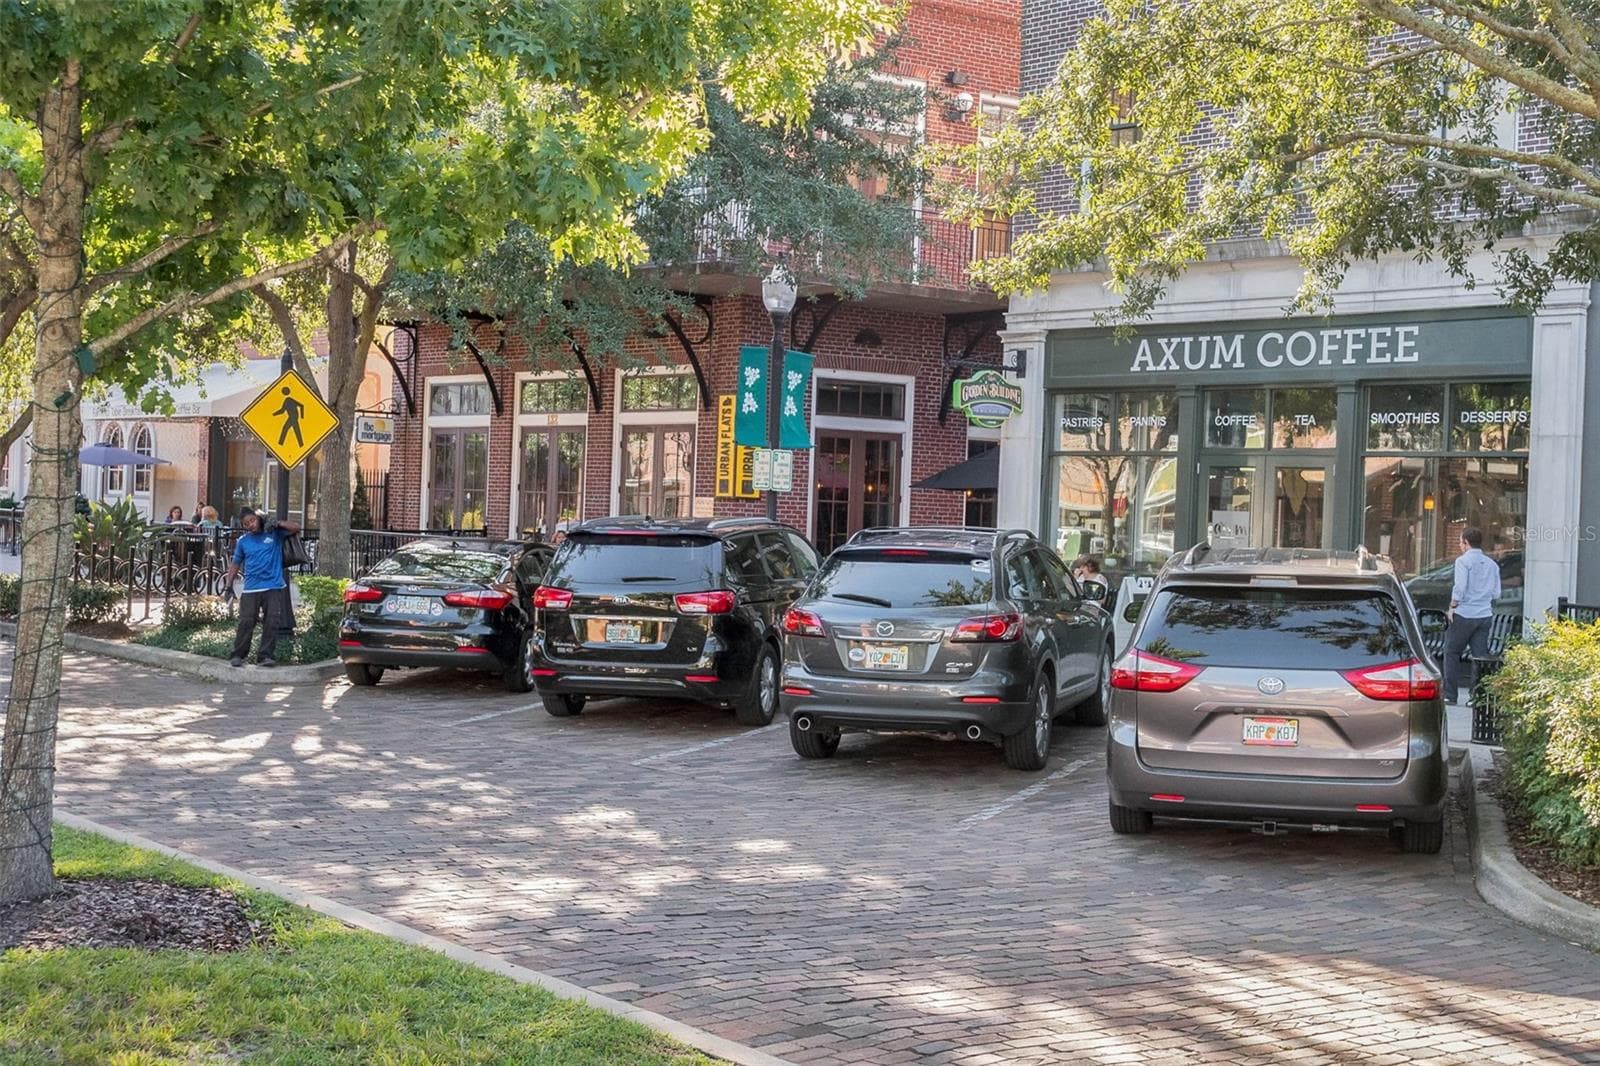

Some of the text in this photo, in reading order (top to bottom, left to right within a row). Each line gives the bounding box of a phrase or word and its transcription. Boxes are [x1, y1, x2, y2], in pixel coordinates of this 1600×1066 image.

[1130, 325, 1420, 372] AXUM COFFEE
[1060, 416, 1104, 428] PASTRIES
[1129, 415, 1167, 427] PANINIS
[1214, 415, 1256, 426] COFFEE
[1295, 414, 1316, 426] TEA
[1370, 412, 1440, 424] SMOOTHIES
[1460, 410, 1528, 423] DESSERTS
[361, 431, 393, 442] mortgage
[720, 407, 732, 477] URBAN FLATS
[743, 446, 756, 478] URBA
